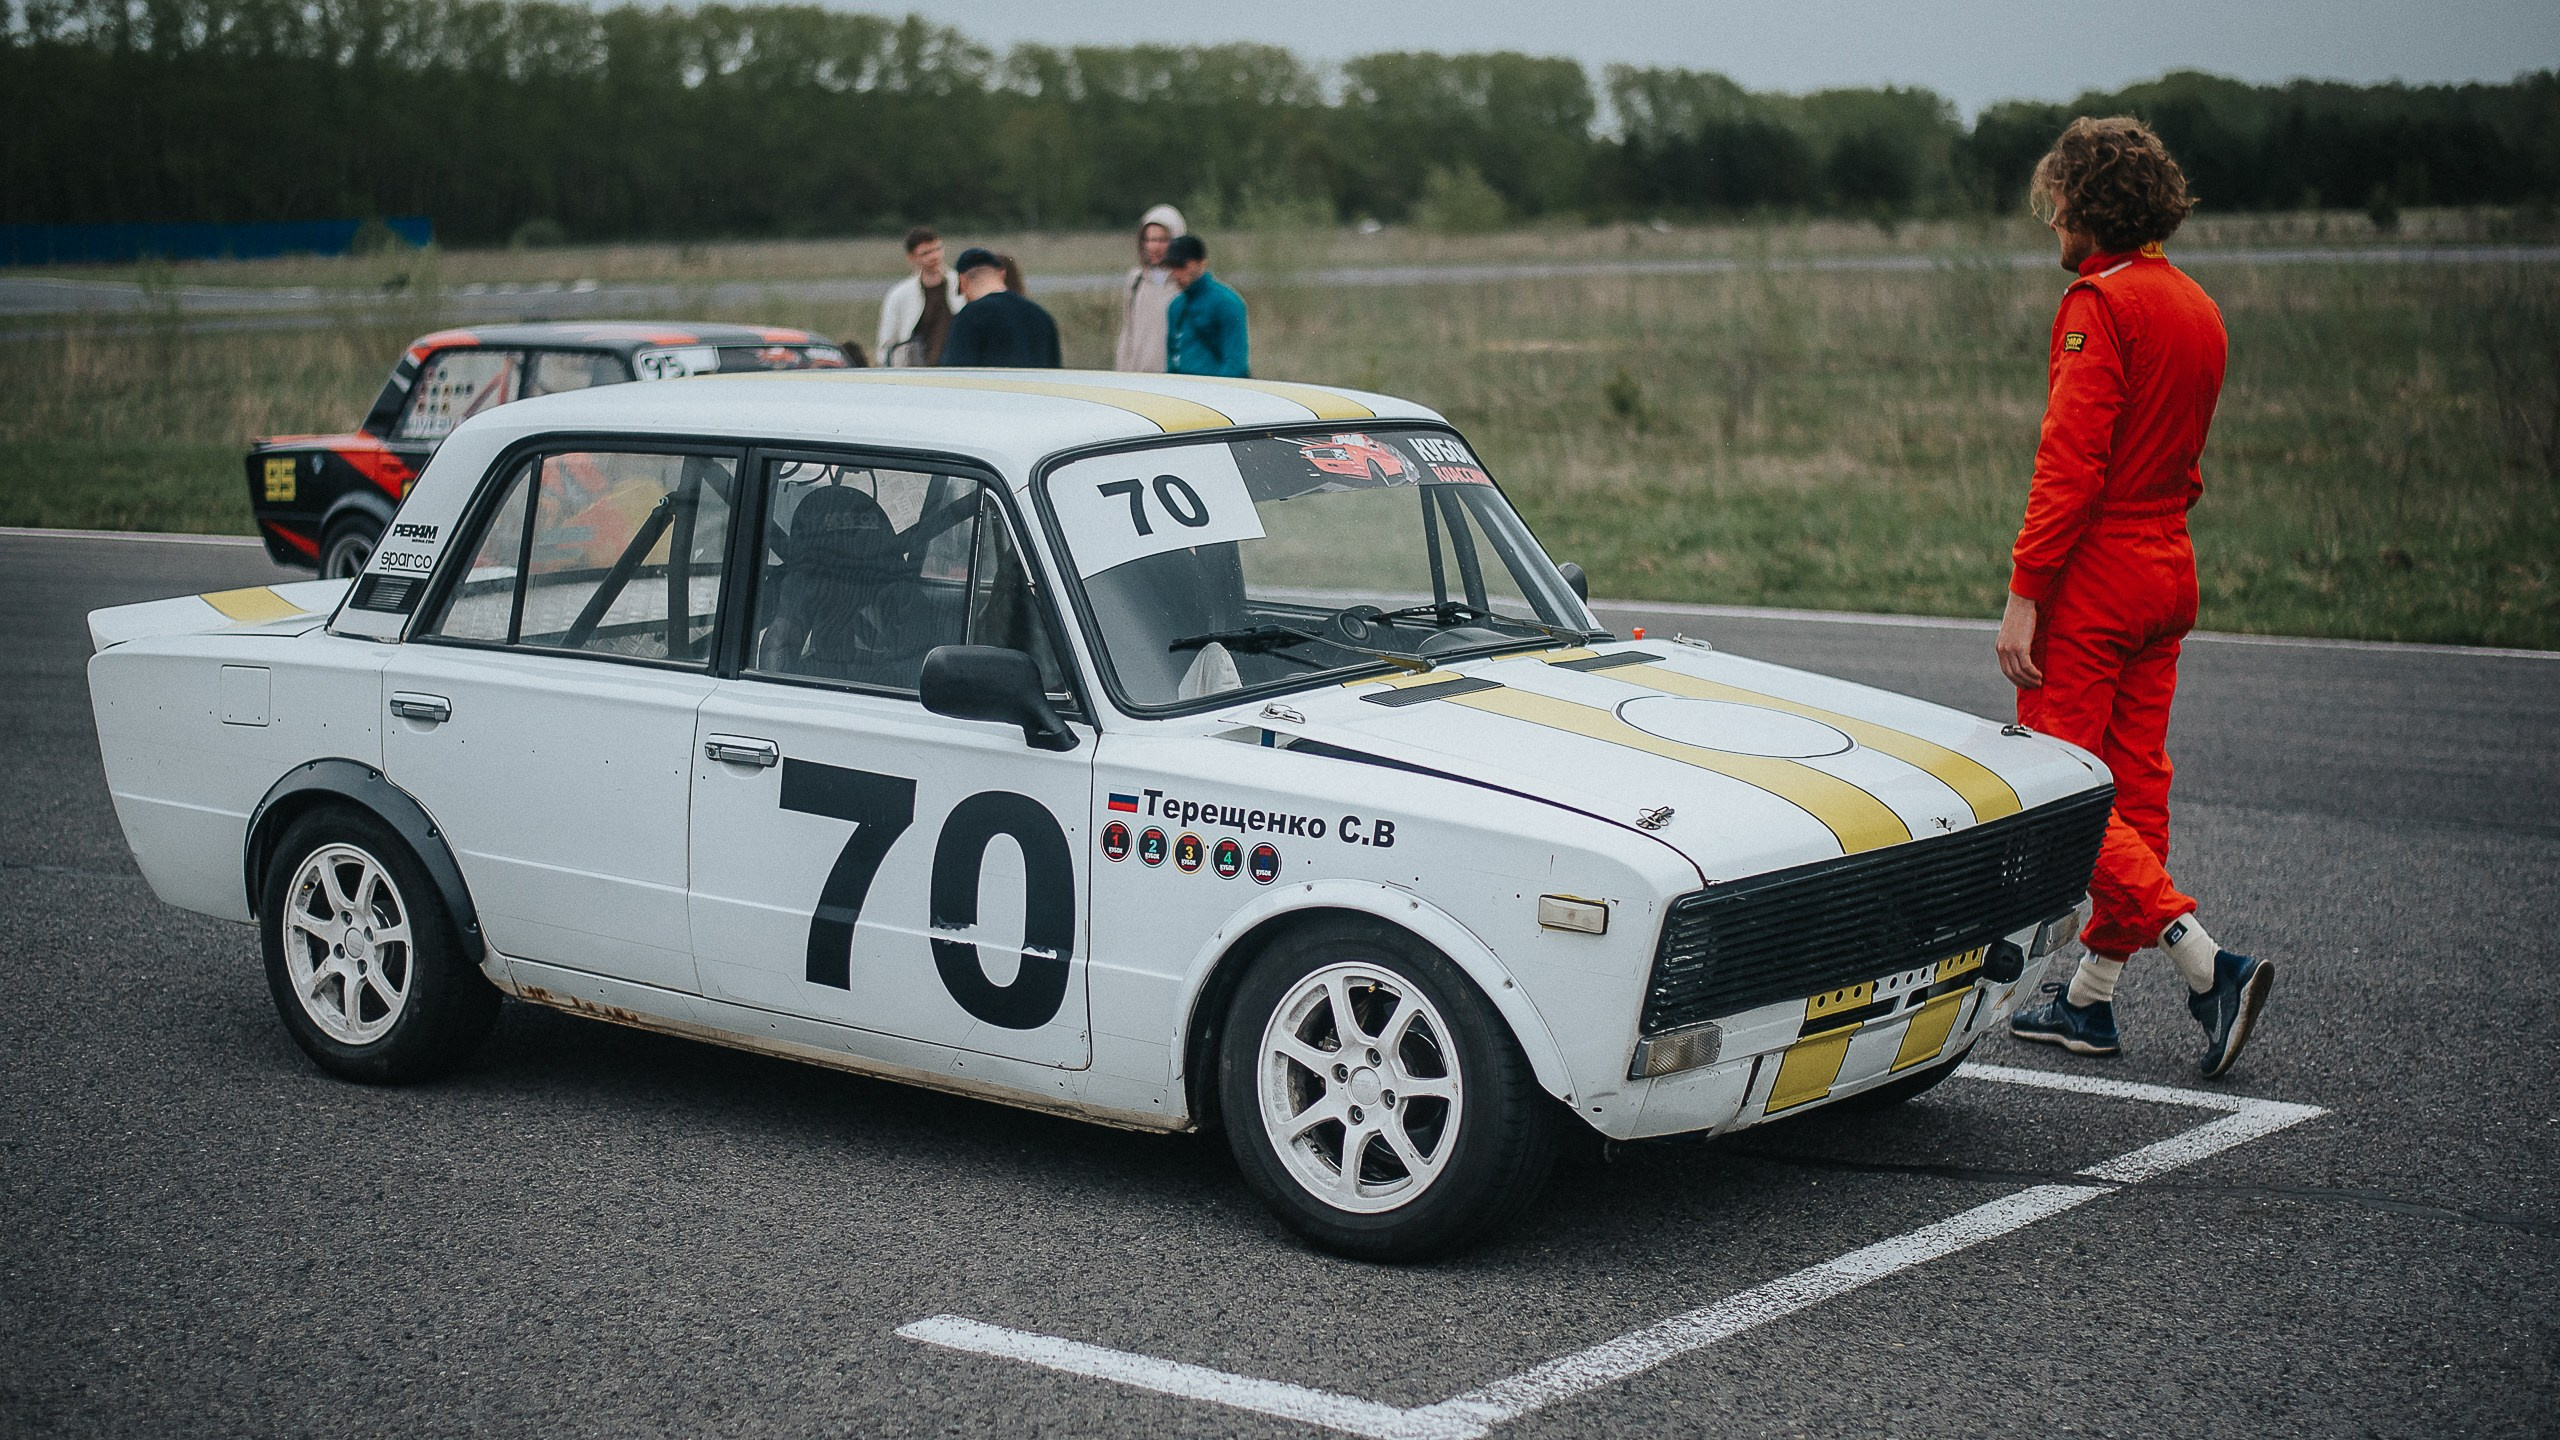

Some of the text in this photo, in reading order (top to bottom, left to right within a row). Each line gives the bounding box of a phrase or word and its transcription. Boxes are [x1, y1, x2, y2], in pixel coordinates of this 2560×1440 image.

[1407, 438, 1478, 468] КУБОК
[1096, 474, 1210, 537] 70
[381, 551, 433, 573] sparco
[1143, 789, 1396, 849] Терещенко С.В
[1112, 834, 1119, 846] 1
[1148, 839, 1157, 853] 2
[1185, 846, 1194, 860] 3
[1223, 851, 1232, 865] 4
[779, 756, 1076, 1030] 70
